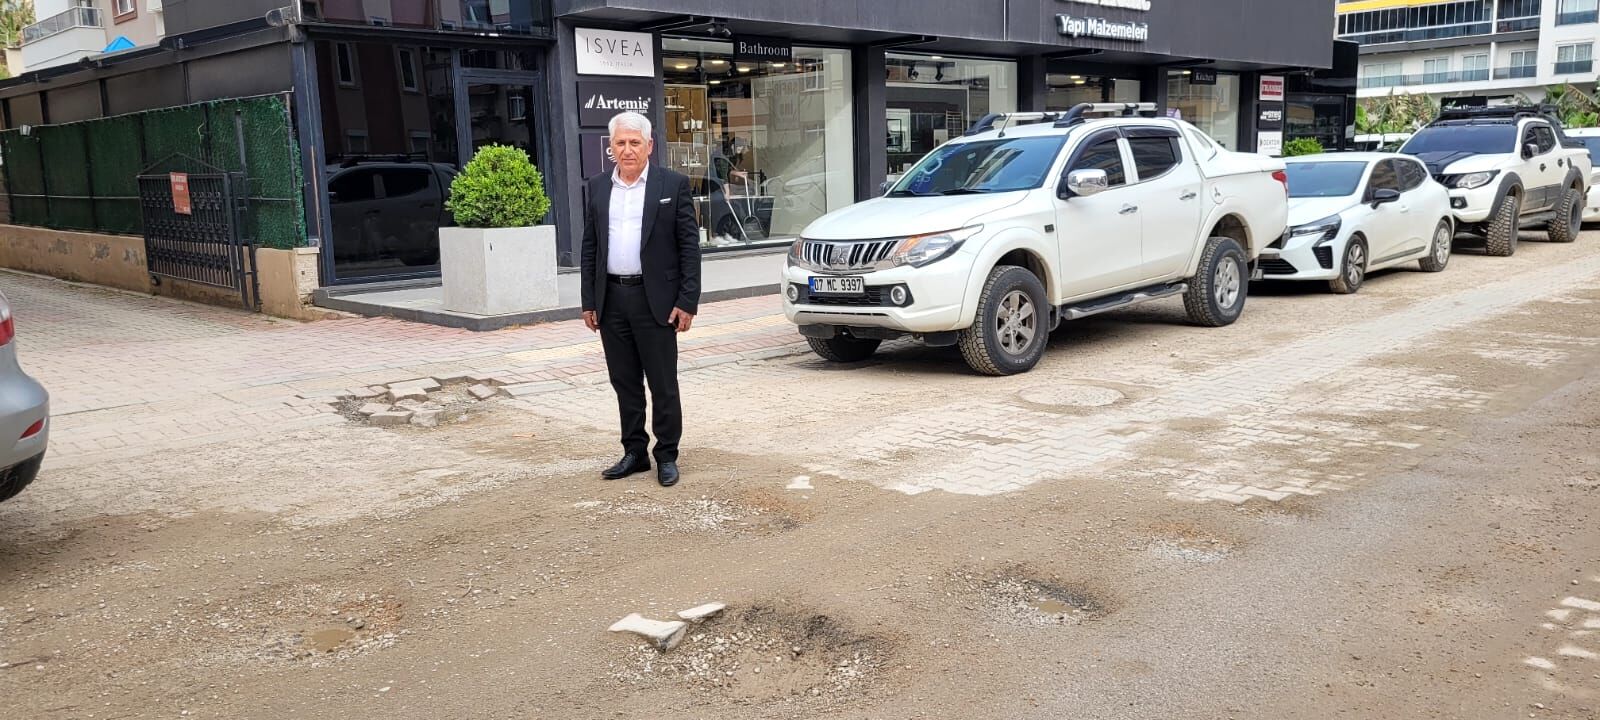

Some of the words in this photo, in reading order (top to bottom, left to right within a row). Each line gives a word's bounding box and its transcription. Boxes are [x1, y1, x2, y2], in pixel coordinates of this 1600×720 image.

[1060, 15, 1086, 38] Yapı
[1087, 18, 1149, 40] Malzemeleri
[585, 36, 645, 57] ISVEA
[739, 41, 789, 57] Bathroom
[596, 94, 649, 110] Artemis
[814, 279, 823, 291] 07
[827, 279, 837, 291] MC
[841, 278, 861, 291] 9397
